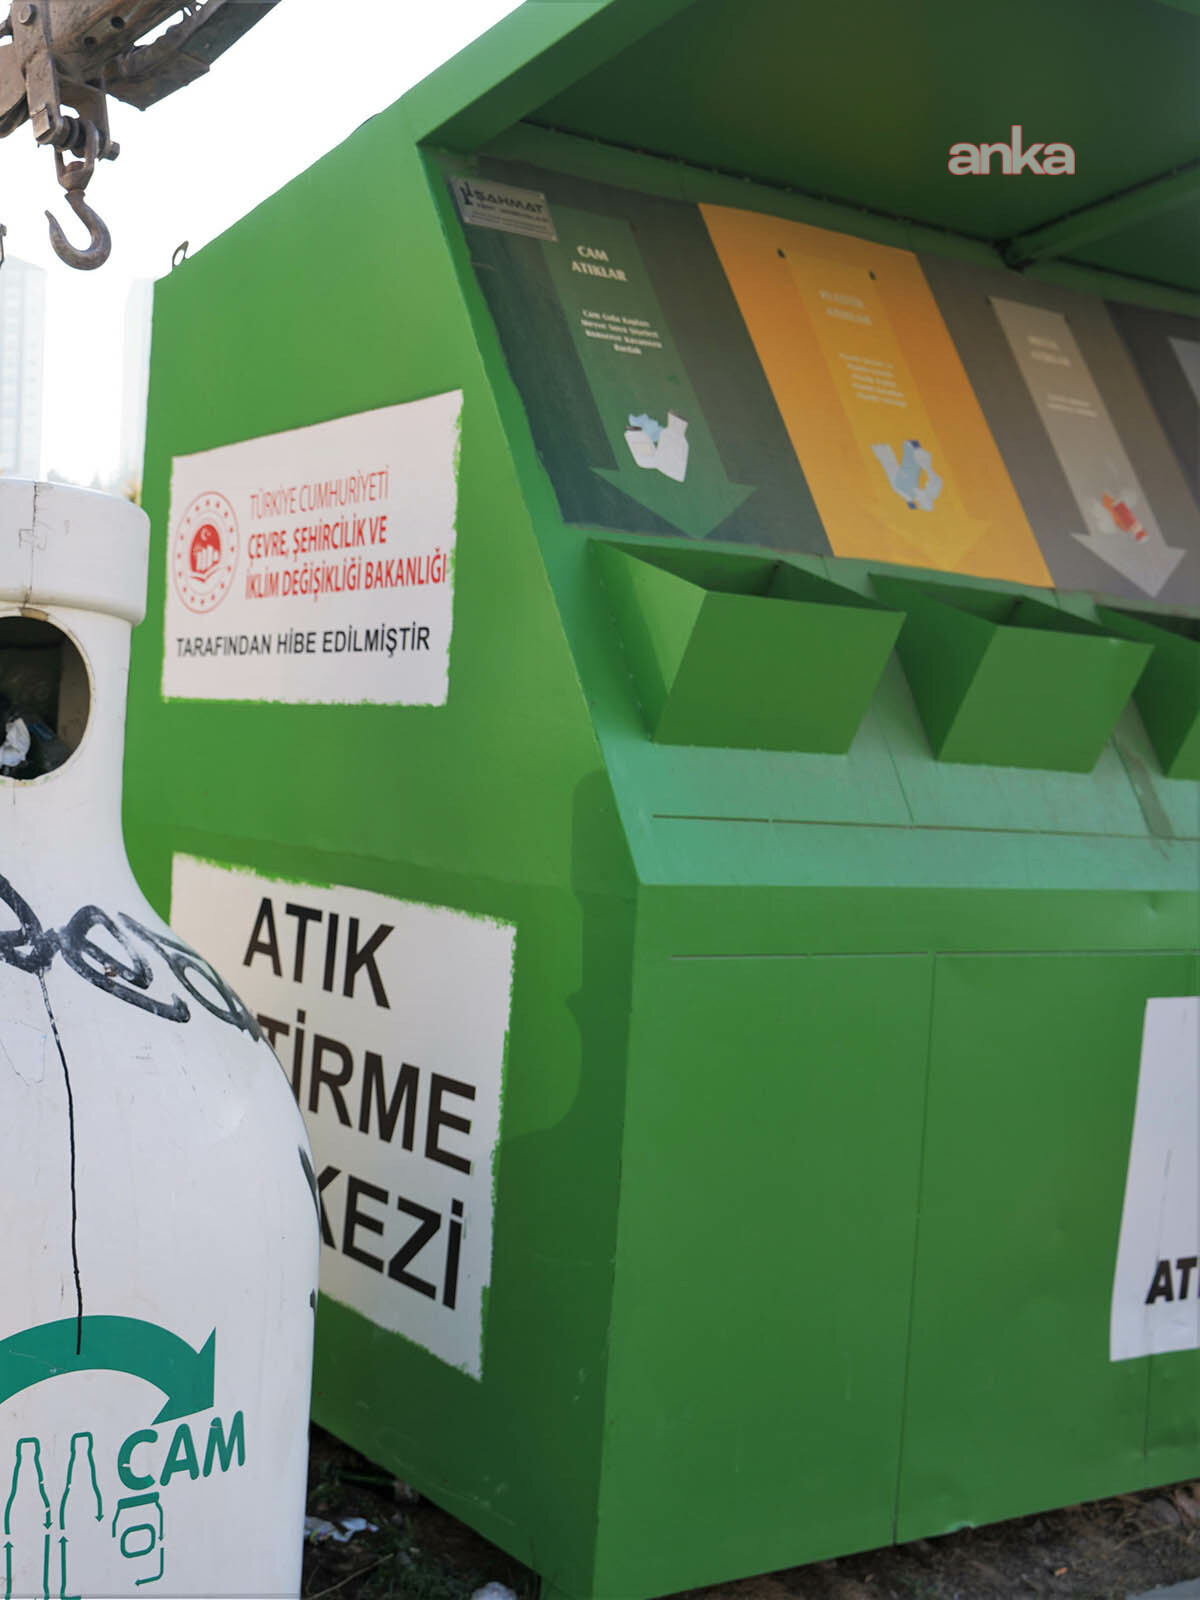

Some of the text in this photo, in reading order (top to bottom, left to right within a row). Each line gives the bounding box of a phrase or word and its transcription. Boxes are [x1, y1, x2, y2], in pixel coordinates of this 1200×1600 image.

[249, 464, 390, 520] TÜRKİYE CUMHURİYETİ
[293, 511, 367, 563] ŞEHİRCİLİK
[369, 515, 388, 545] VE
[364, 546, 448, 590] BAKANLIĞI
[176, 620, 431, 658] TARAFINDAN HİBE EDİLMİŞTİR
[243, 896, 395, 1010] ATIK
[1145, 1256, 1200, 1304] AT
[117, 1410, 246, 1491] CAM
